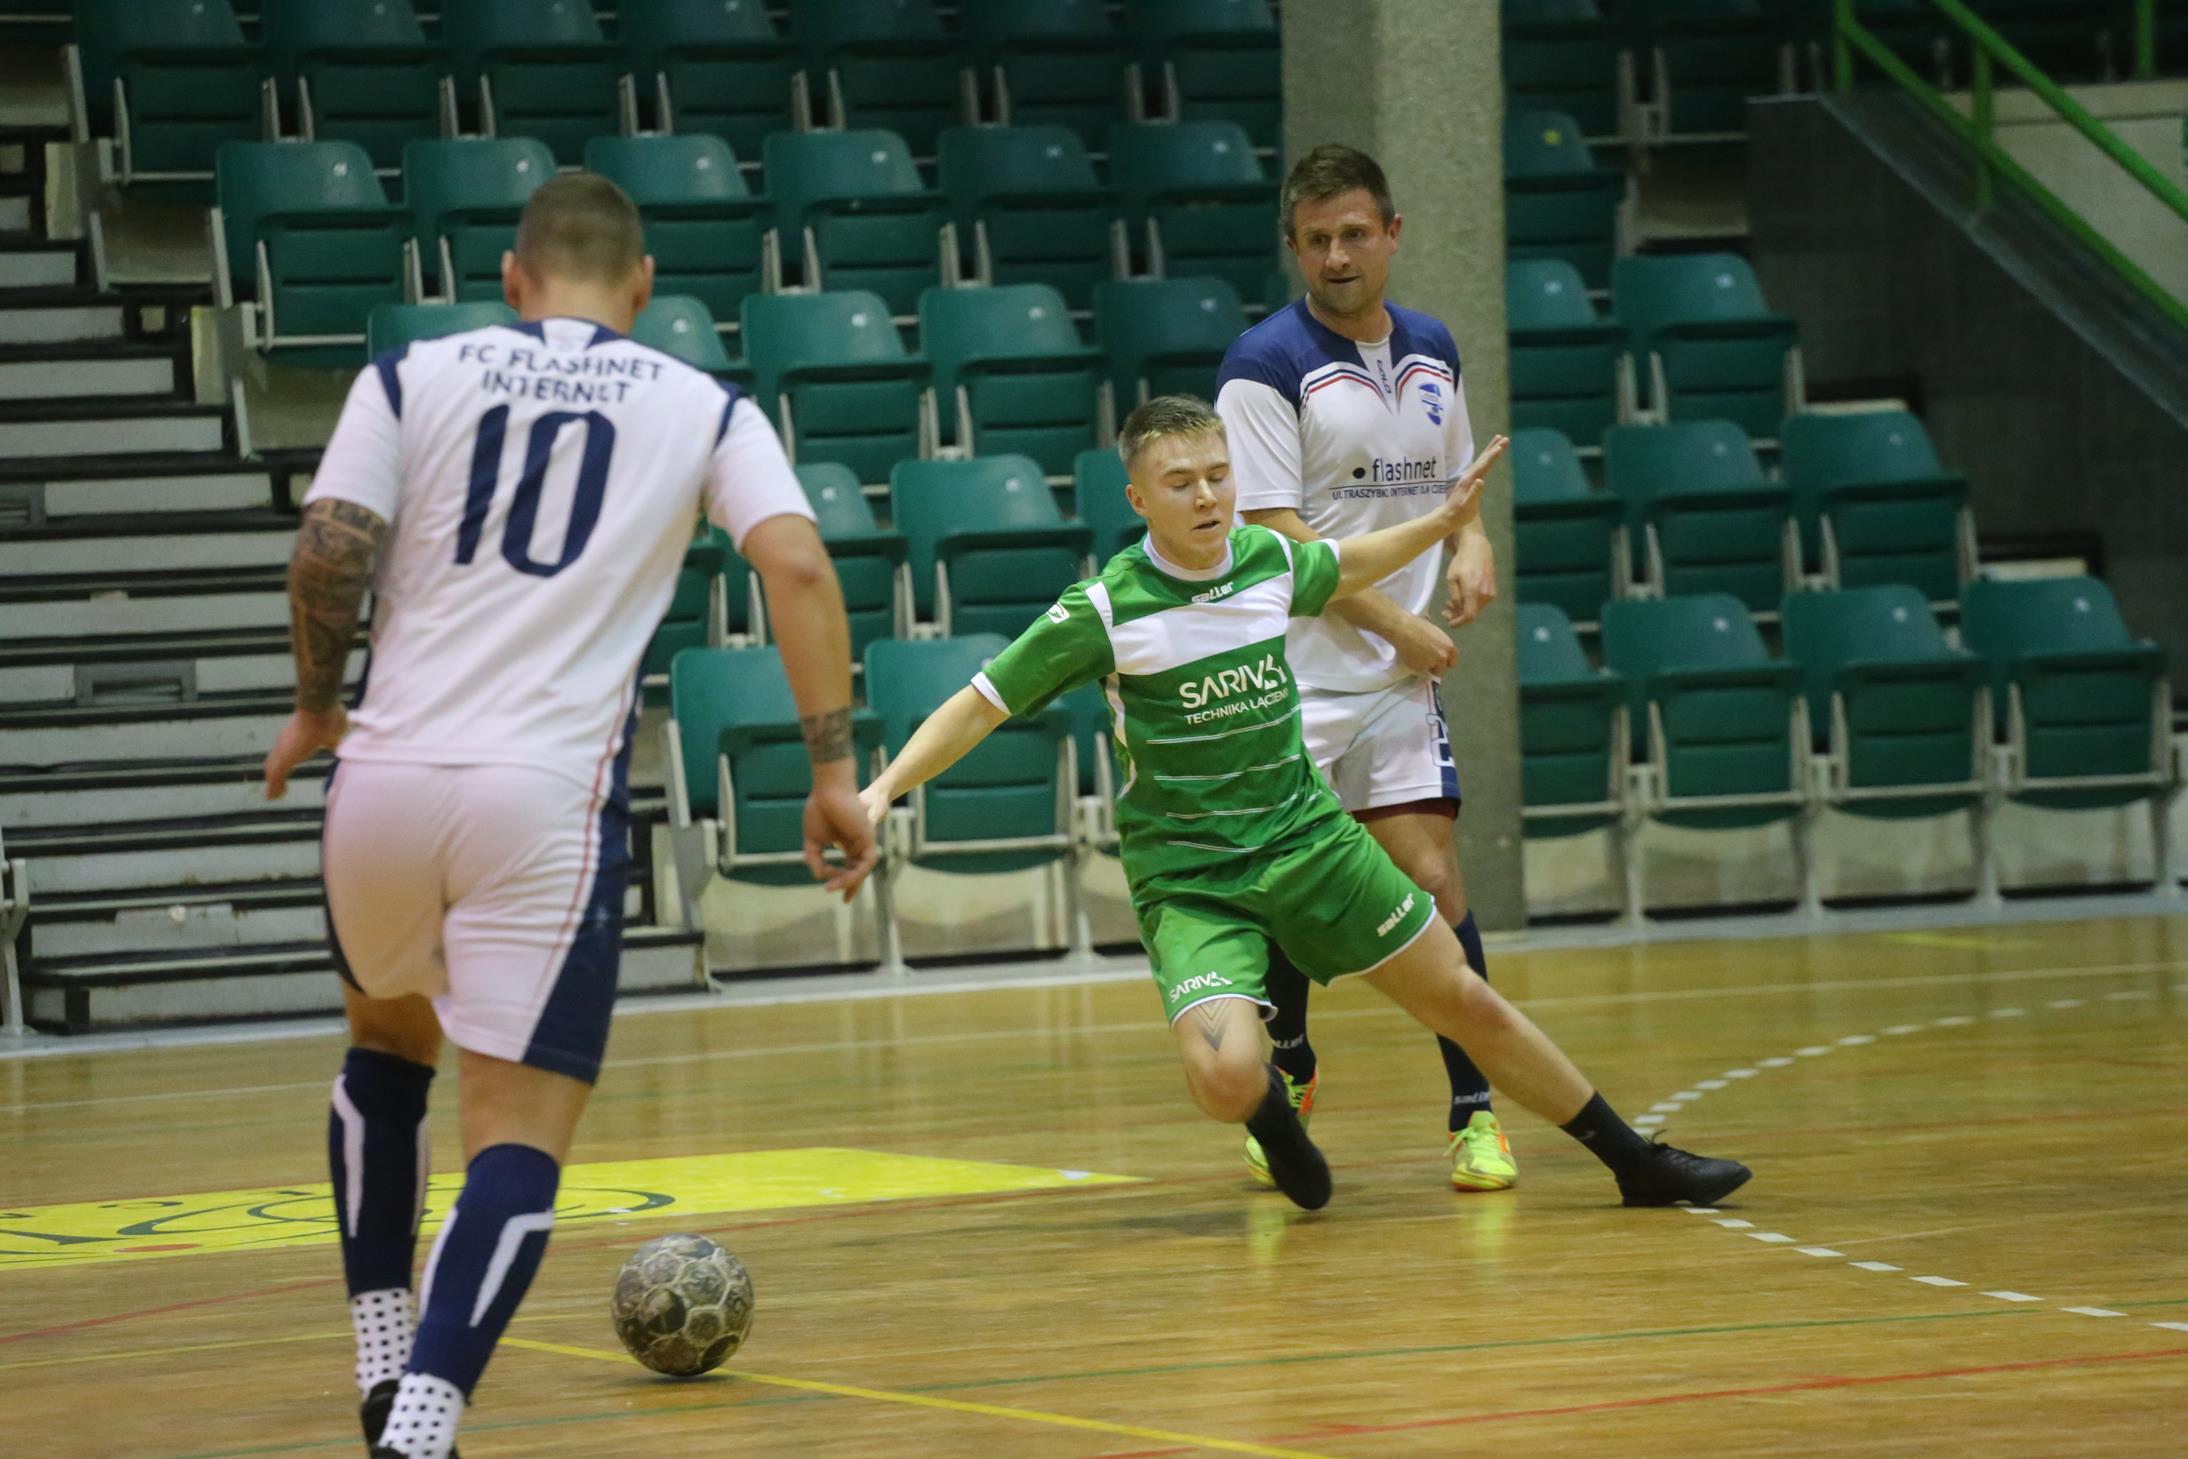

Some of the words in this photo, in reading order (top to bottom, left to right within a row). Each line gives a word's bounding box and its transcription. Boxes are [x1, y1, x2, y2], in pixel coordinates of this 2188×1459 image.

[458, 344, 494, 363] FC
[507, 349, 663, 380] FLASHNET
[482, 370, 631, 403] INTERNET
[1372, 456, 1437, 482] flashnet
[454, 403, 616, 579] 10
[1184, 702, 1249, 725] TECHNIKA
